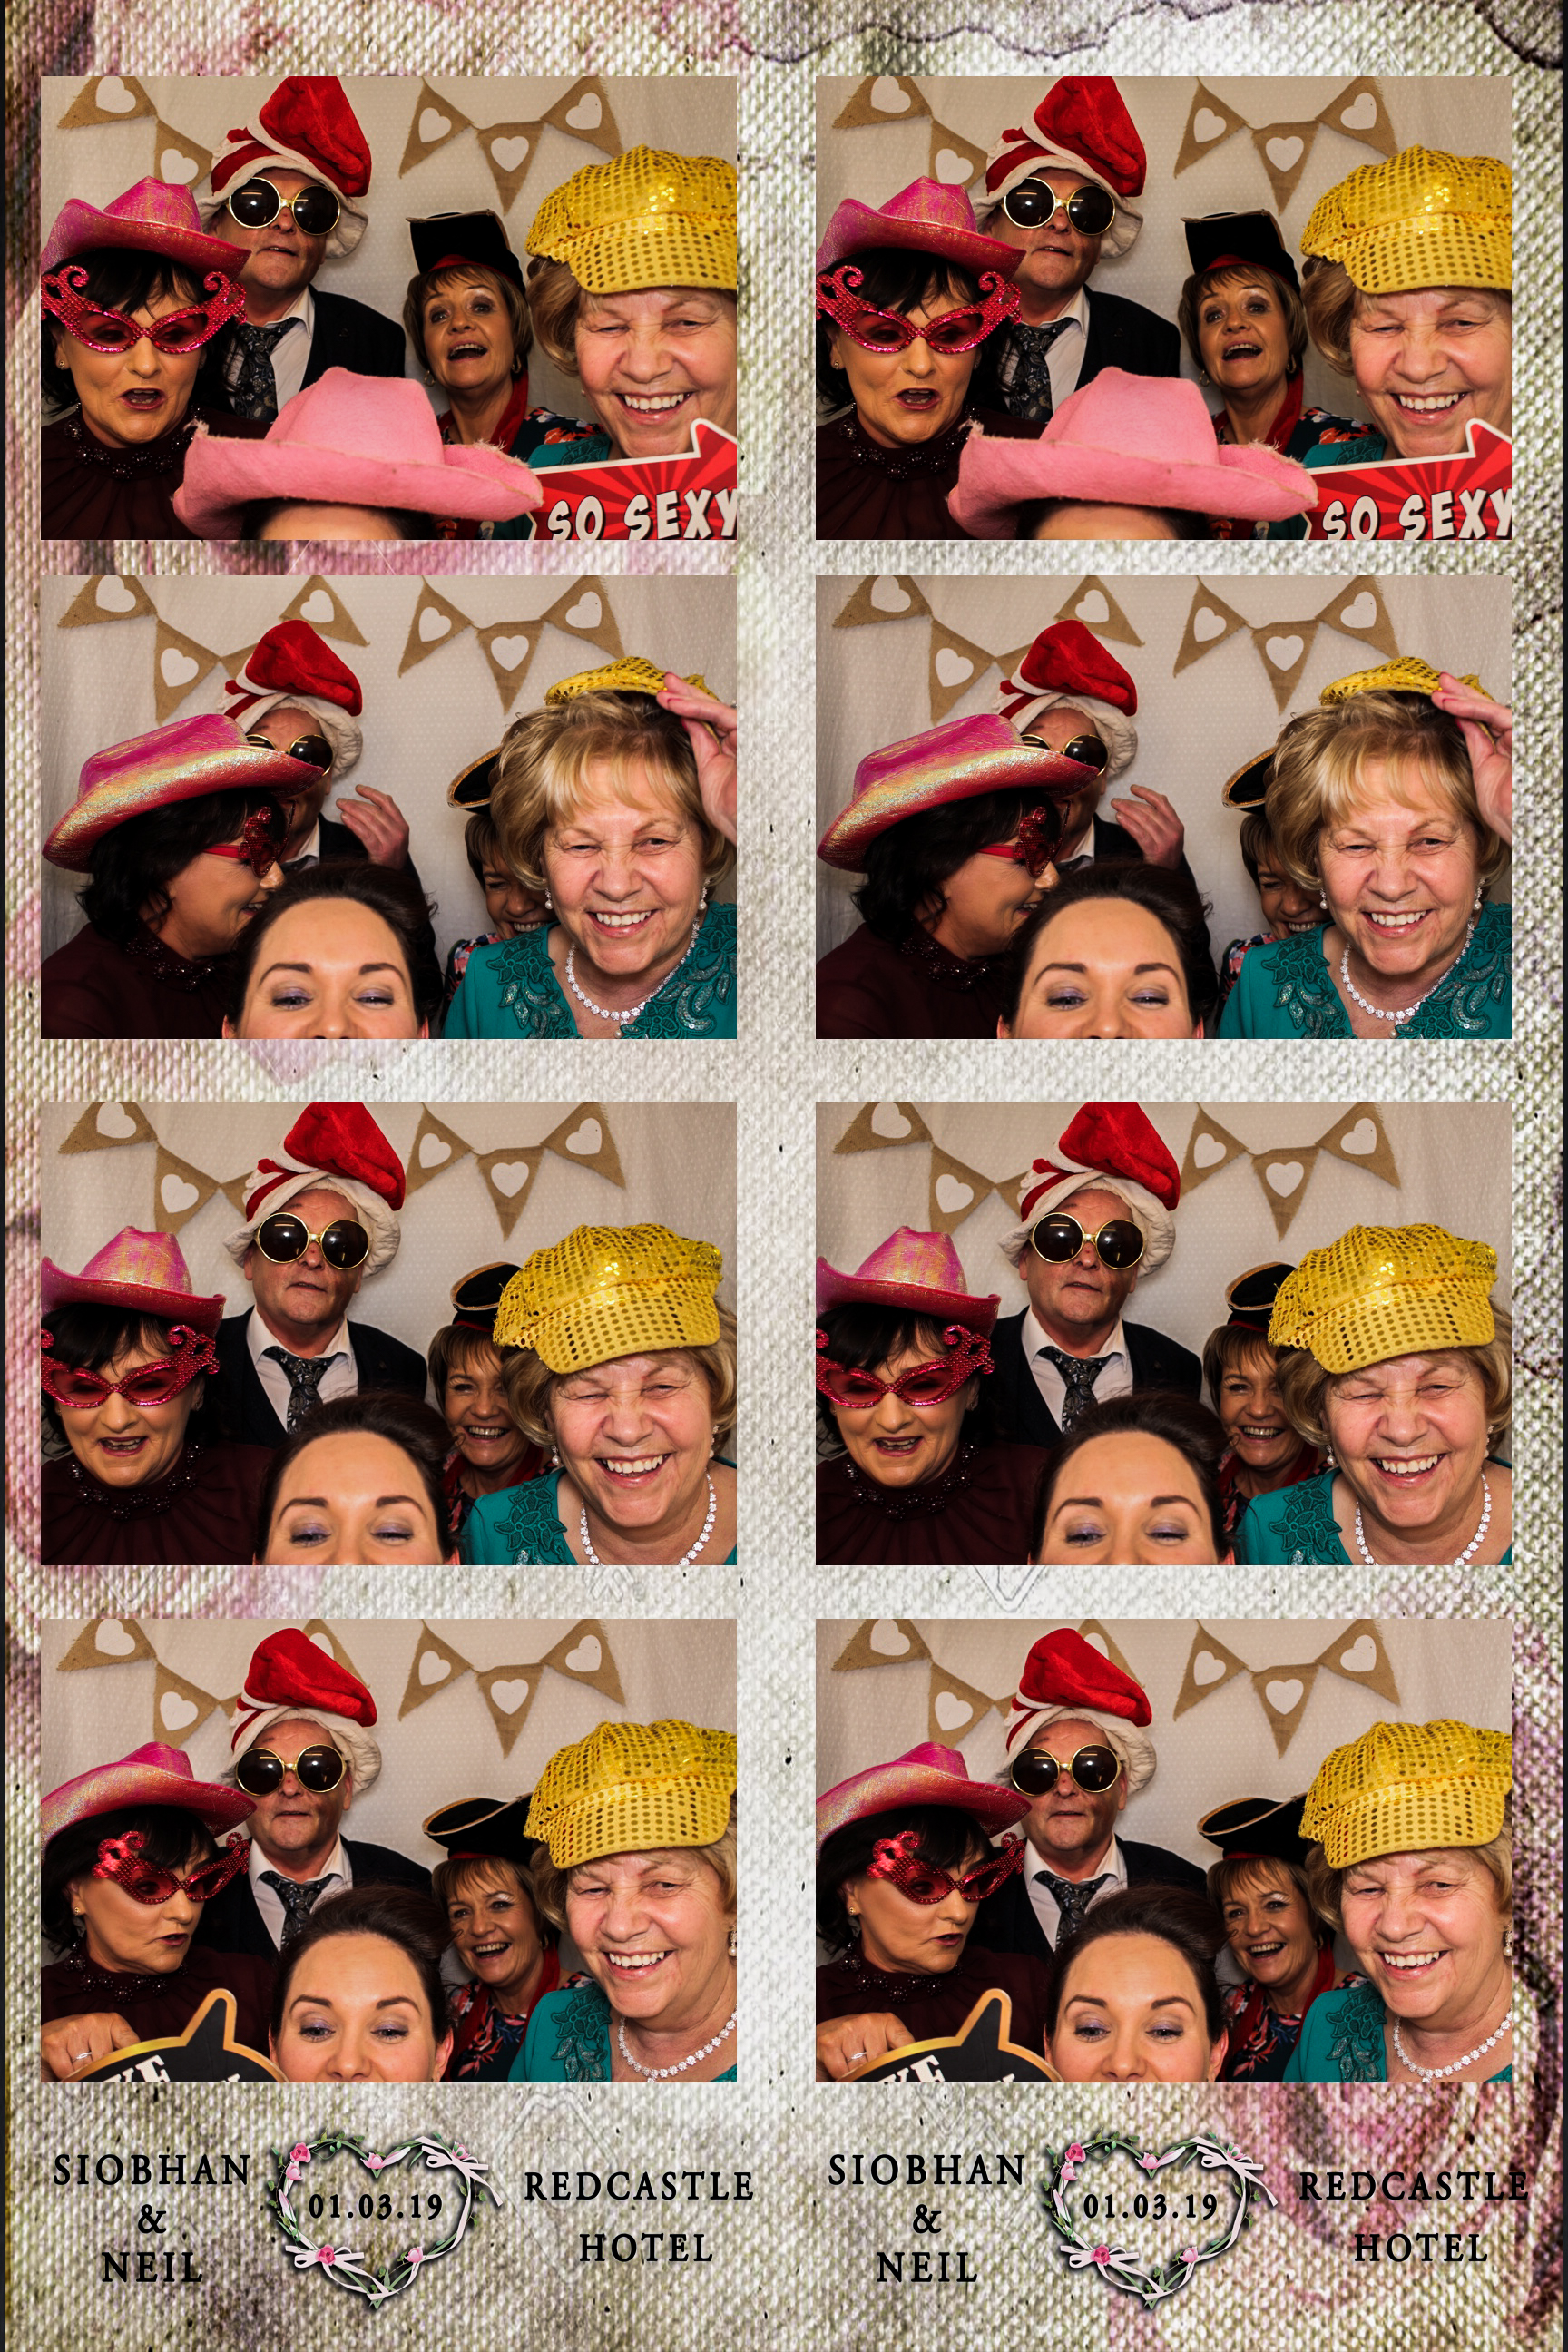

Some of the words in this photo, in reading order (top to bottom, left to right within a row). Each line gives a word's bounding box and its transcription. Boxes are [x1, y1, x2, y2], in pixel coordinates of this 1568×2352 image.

[547, 495, 605, 540] SO
[623, 488, 737, 540] SEXY
[1322, 495, 1379, 540] SO
[1398, 488, 1512, 540] SEXY
